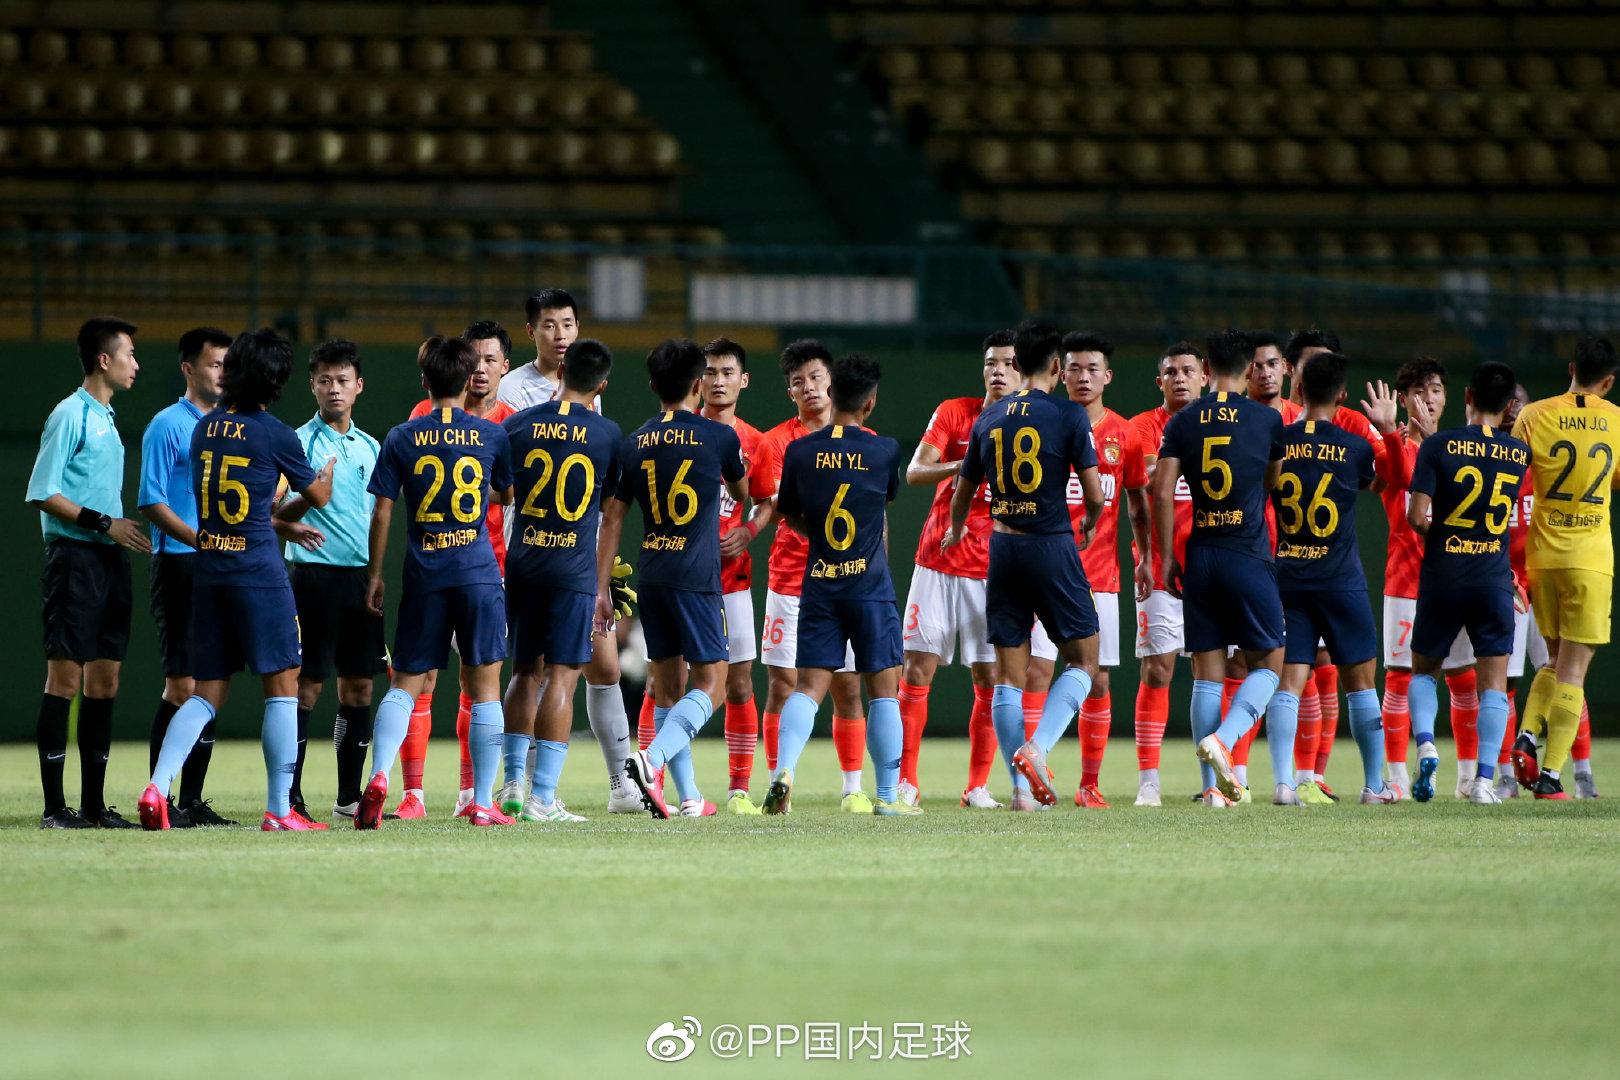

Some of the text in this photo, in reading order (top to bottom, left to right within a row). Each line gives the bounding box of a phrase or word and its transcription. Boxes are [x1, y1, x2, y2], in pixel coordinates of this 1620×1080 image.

[1006, 402, 1031, 417] YI T.
[1200, 407, 1239, 424] LI S.Y.
[1559, 416, 1586, 431] HAN
[207, 421, 247, 441] LI T.X.
[414, 428, 484, 447] WU CH.R.
[532, 423, 588, 444] TANG M.
[636, 429, 704, 450] TAN CH.L.
[815, 452, 869, 471] FAN Y.L.
[989, 426, 1043, 494] 18
[1317, 444, 1347, 462] ZH.Y.
[1447, 440, 1486, 457] CHEN
[1201, 436, 1233, 501] 5
[1545, 440, 1613, 505] 22
[200, 450, 252, 525] 15
[414, 454, 484, 523] 28
[520, 448, 596, 522] 20
[640, 459, 699, 526] 16
[1279, 472, 1339, 538] 36
[1443, 465, 1520, 535] 25
[824, 483, 856, 551] 6
[906, 603, 919, 631] 3
[1138, 610, 1150, 638] 9
[1398, 619, 1413, 647] 7
